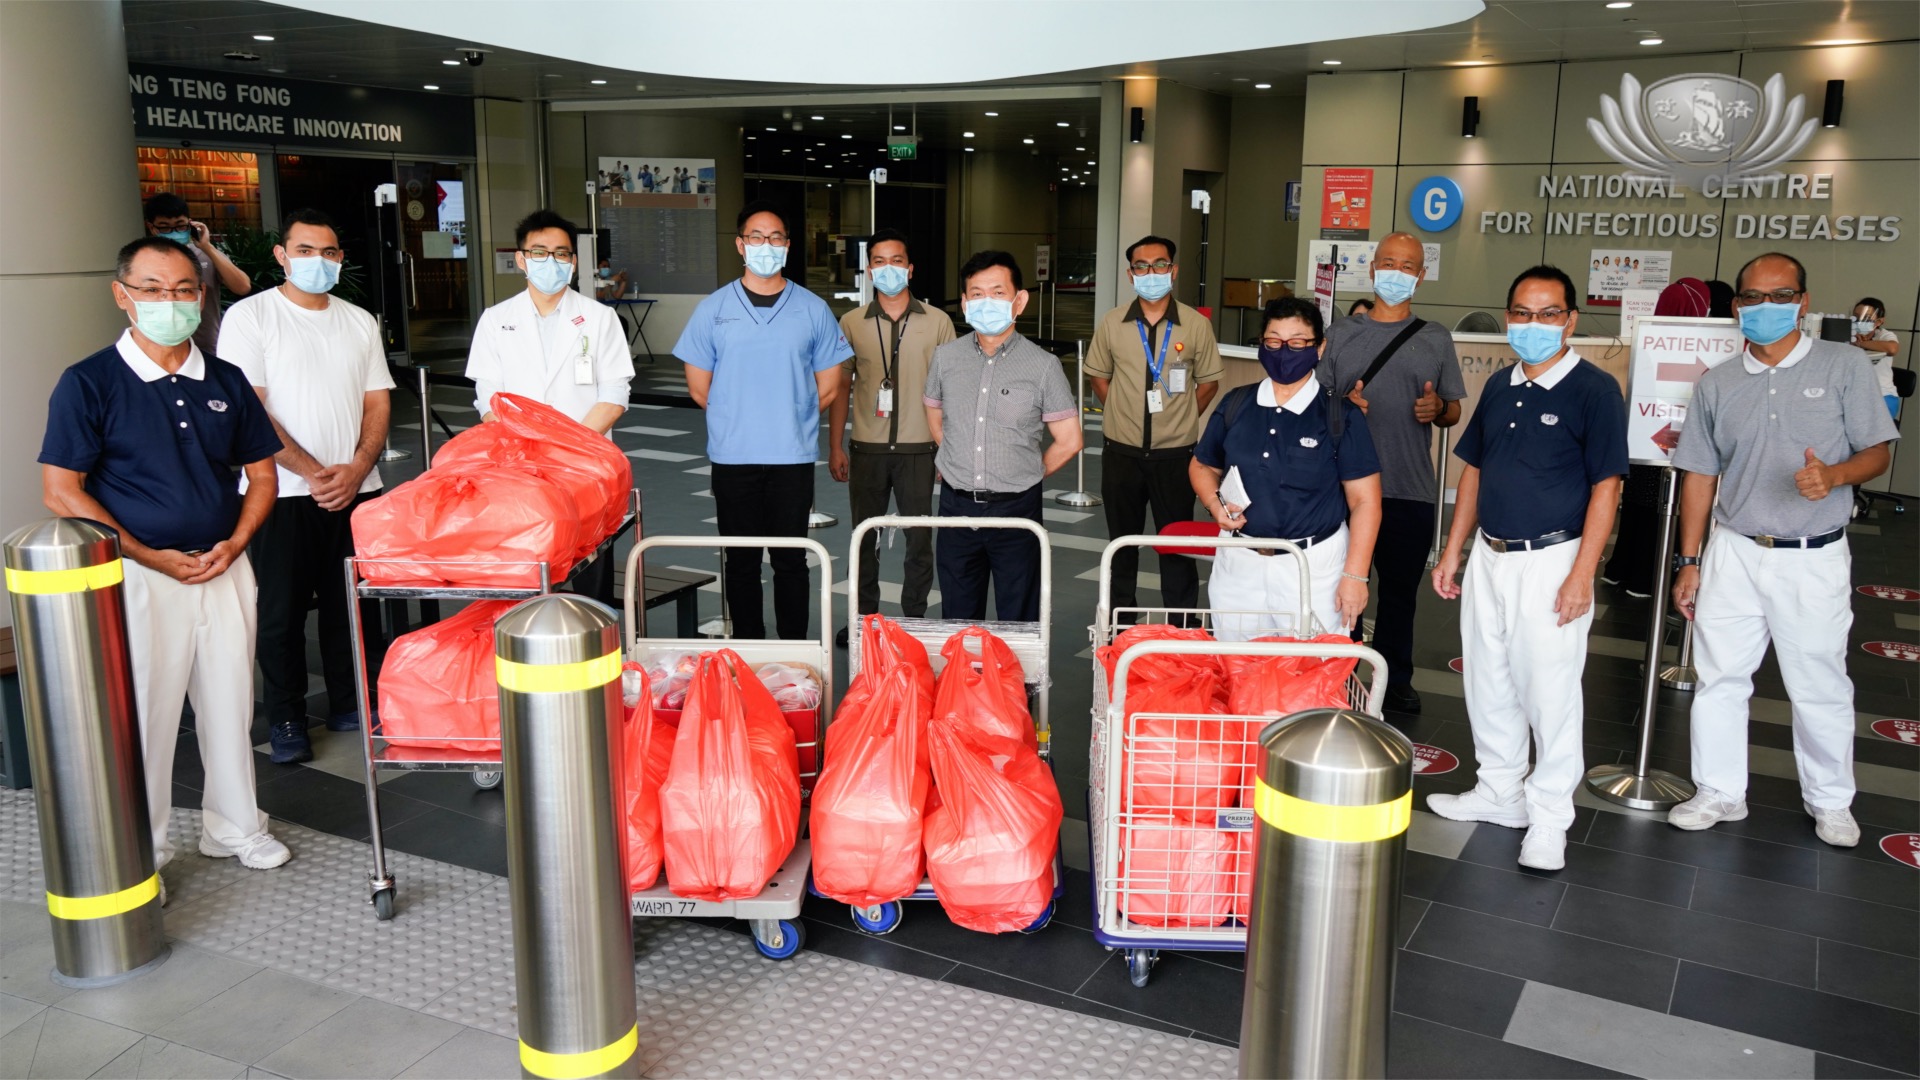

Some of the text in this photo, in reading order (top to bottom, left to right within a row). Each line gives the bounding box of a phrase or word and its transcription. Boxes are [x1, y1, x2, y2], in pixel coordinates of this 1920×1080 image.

[128, 73, 291, 107] NG TENG FONG
[146, 106, 285, 135] HEALTHCARE
[293, 117, 402, 142] INNOVATION
[891, 146, 908, 157] EXIT
[1538, 173, 1833, 199] NATIONAL CENTRE
[612, 193, 623, 207] H
[1423, 187, 1448, 221] G
[1479, 211, 1902, 242] FOR INFECTIOUS DISEASES
[1643, 335, 1735, 354] PATIENTS
[632, 900, 696, 915] WARD 77
